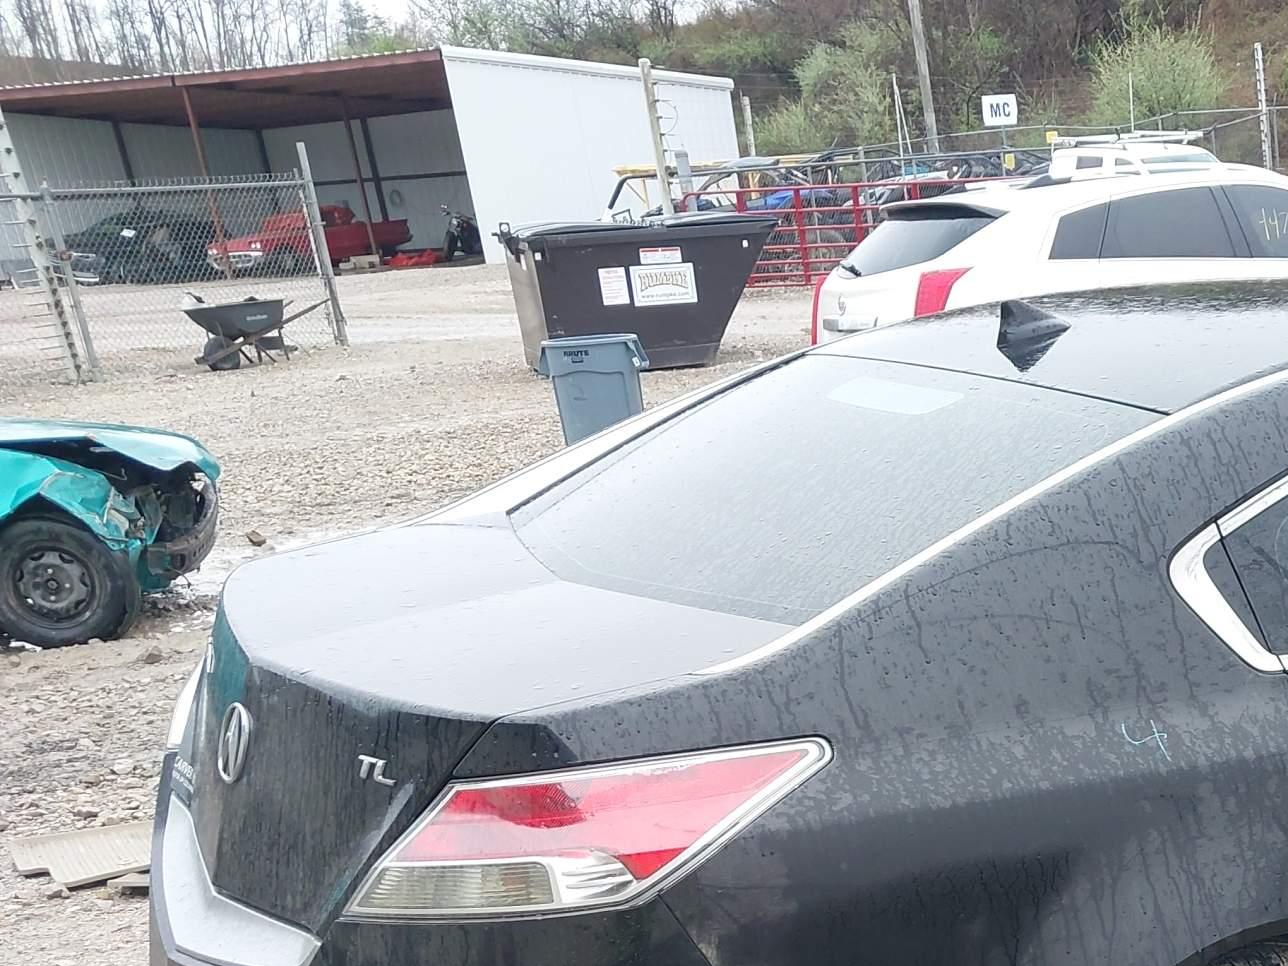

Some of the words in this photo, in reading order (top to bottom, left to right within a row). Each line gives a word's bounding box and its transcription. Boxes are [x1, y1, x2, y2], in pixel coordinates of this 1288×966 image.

[990, 102, 1011, 118] MC
[1121, 719, 1172, 762] 4
[357, 754, 397, 787] TL
